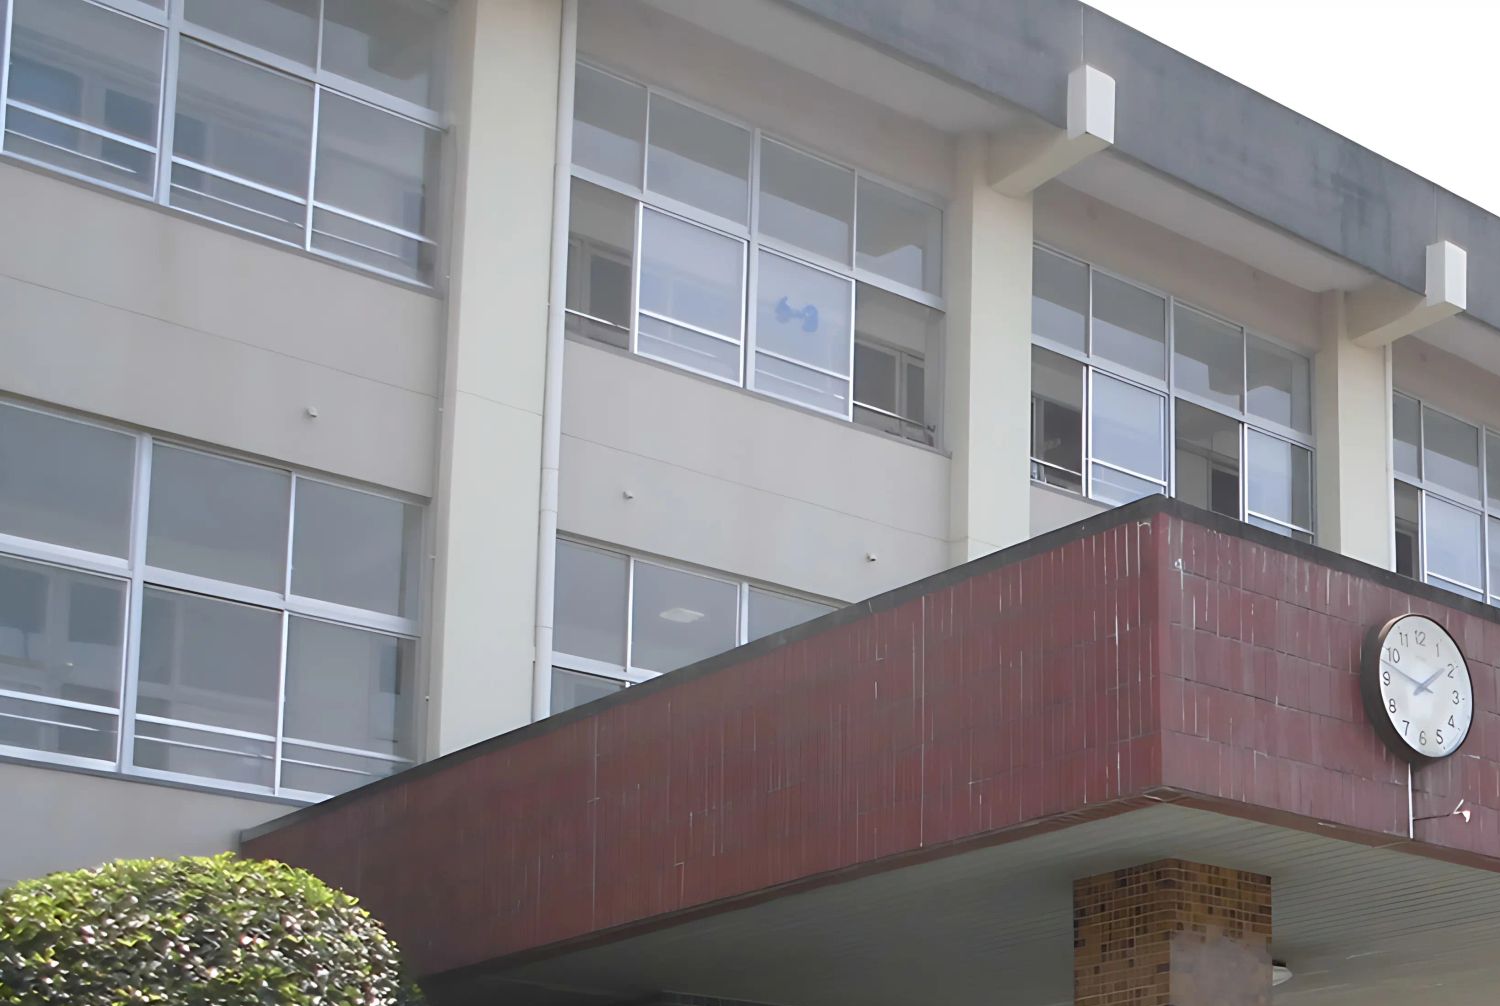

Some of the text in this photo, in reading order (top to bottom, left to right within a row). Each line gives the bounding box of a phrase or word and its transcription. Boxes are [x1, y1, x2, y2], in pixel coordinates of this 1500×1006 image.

[1399, 632, 1409, 648] 11
[1415, 630, 1426, 647] 12
[1387, 647, 1400, 663] 10
[1435, 643, 1440, 657] 1
[1447, 663, 1456, 678] 2
[1382, 671, 1391, 686] 9
[1452, 690, 1460, 705] 3
[1388, 698, 1397, 713] 8
[1402, 720, 1410, 736] 7
[1447, 714, 1455, 728] 4
[1419, 730, 1427, 746] 6
[1435, 729, 1444, 745] 5
